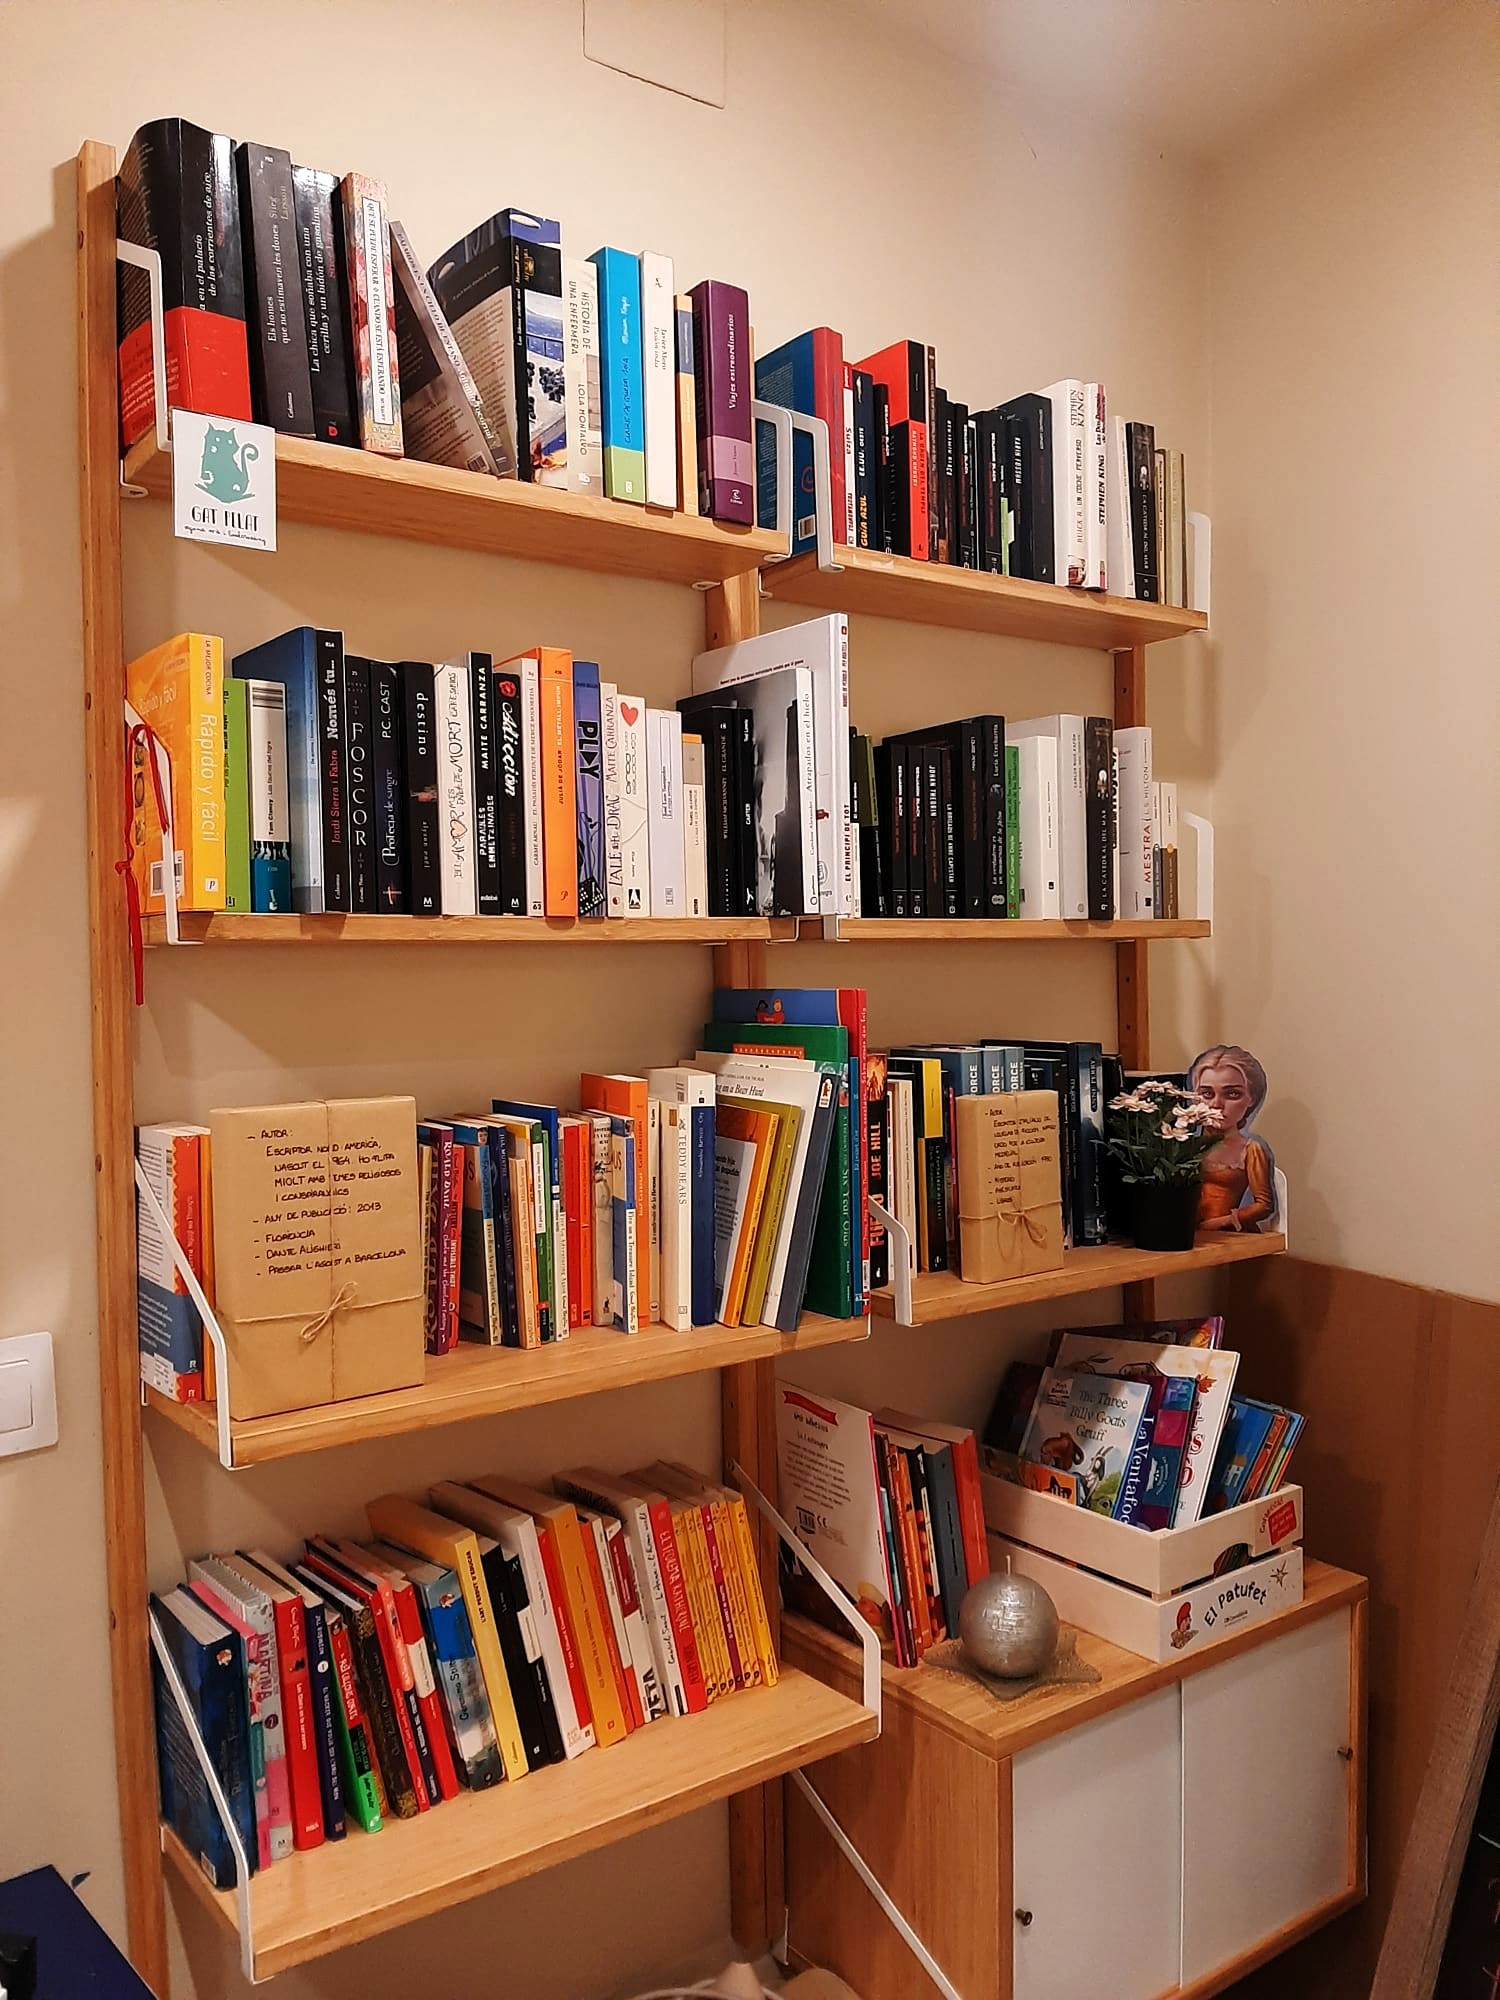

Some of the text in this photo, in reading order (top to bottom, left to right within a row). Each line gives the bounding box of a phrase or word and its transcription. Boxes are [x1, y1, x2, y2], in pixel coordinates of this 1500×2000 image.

[206, 213, 215, 263] corrientes
[194, 235, 206, 301] en el palacio
[316, 251, 325, 263] de
[207, 265, 216, 283] las
[271, 225, 291, 344] que no estimaven les dones
[315, 265, 326, 293] bidón
[208, 286, 217, 296] de
[302, 227, 320, 372] La chica que soñaba con una
[318, 296, 327, 310] un
[266, 296, 277, 341] Els homes
[568, 281, 579, 355] UNA ENFERMERA
[580, 292, 591, 349] HISTORIA DE
[320, 323, 330, 353] cerilla
[727, 313, 737, 409] Viajes extraordinarios
[577, 383, 588, 456] LOLA MONTALVO
[192, 506, 217, 524] GAT
[859, 495, 868, 546] GUÍA AZUL
[204, 639, 211, 648] LA
[323, 660, 338, 739] Només tu...
[380, 681, 391, 738] P.C. CAST
[416, 692, 428, 755] destino
[478, 667, 489, 769] MAITE CARRANZA
[501, 701, 518, 797] Adicción
[605, 696, 617, 782] MAITE CARRANZA
[802, 693, 814, 792] Atrapados en el hielo
[197, 713, 218, 842] Rápido y fácil
[329, 750, 338, 777] Fabra
[384, 769, 397, 799] sangre
[557, 775, 563, 784] DE
[330, 788, 339, 817] Sierra
[606, 795, 621, 829] DRAC
[331, 820, 342, 844] Jordi
[845, 822, 850, 831] DE
[1143, 825, 1152, 883] MESTRA
[845, 874, 851, 882] EL
[1101, 886, 1107, 897] LA
[735, 1084, 748, 1095] Bear
[750, 1085, 764, 1097] Hunt
[313, 1161, 324, 1169] EL
[359, 1155, 370, 1164] HO
[444, 1141, 452, 1177] ROALD
[870, 1122, 882, 1179] JOE HILL
[678, 1135, 687, 1205] TEDDY BEARS
[287, 1212, 298, 1220] DE
[357, 1202, 381, 1213] 2013
[266, 1248, 296, 1259] DANTE
[354, 1249, 406, 1264] BARCELONA
[1098, 1391, 1129, 1410] Three
[1070, 1406, 1127, 1428] Billy Goats
[1139, 1416, 1155, 1440] La
[1075, 1425, 1107, 1442] Gruff
[1204, 1606, 1218, 1627] El
[255, 1632, 273, 1700] MARTINA
